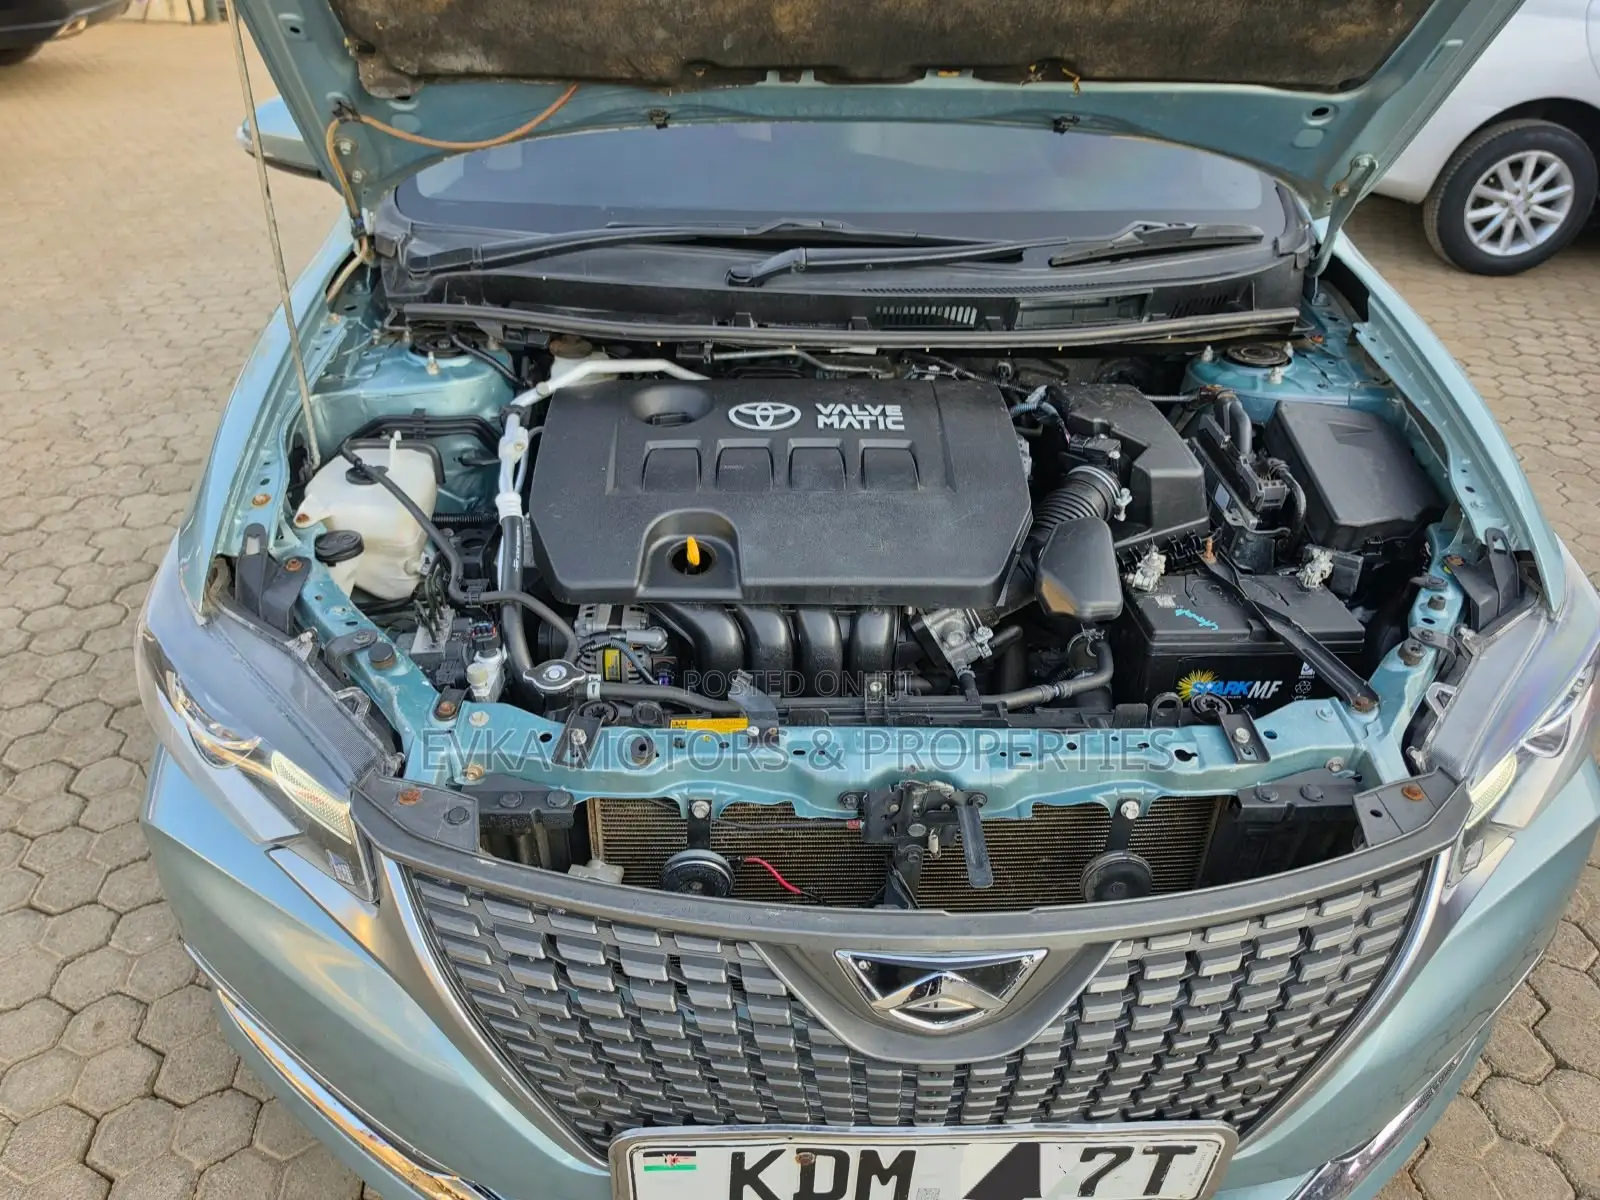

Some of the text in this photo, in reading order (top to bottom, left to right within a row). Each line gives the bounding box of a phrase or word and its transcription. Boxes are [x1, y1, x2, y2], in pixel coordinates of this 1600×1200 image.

[815, 403, 903, 416] VALVE
[816, 415, 905, 430] MATIC
[729, 1148, 916, 1200] KDM
